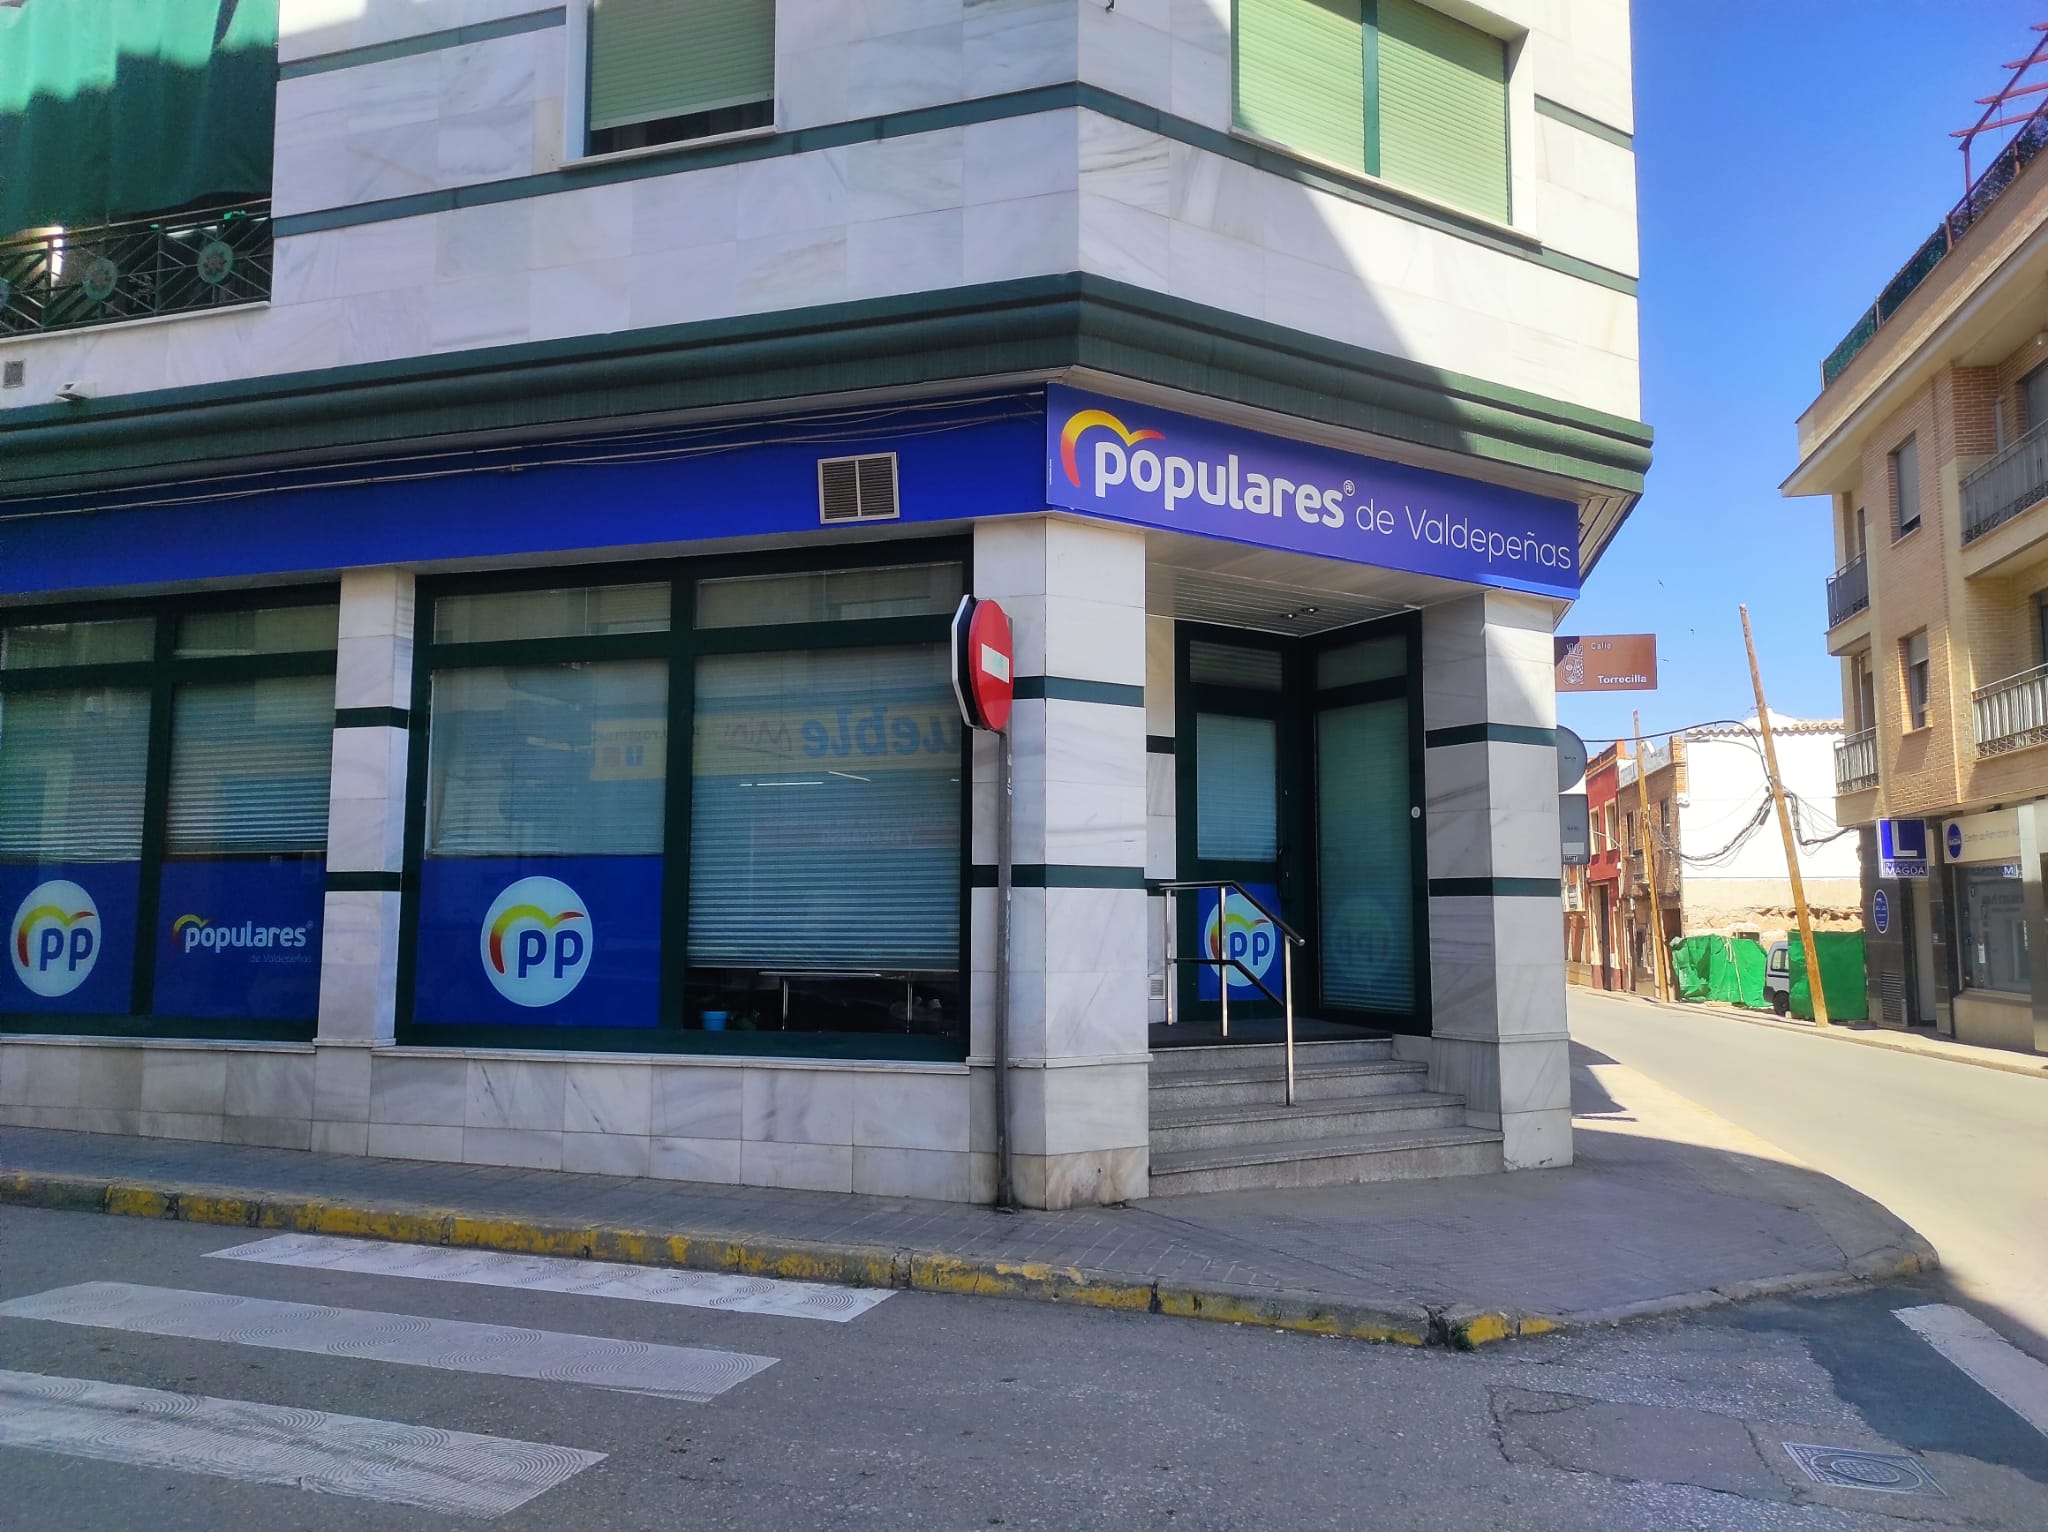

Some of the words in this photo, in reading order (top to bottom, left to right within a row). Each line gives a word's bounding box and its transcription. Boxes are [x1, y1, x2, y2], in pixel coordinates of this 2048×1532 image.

[1095, 440, 1344, 529] populares
[1355, 497, 1394, 536] de
[1405, 504, 1572, 571] Valdepeñas
[1590, 641, 1612, 650] Calle
[1597, 674, 1648, 684] Torrecilla
[1891, 820, 1918, 857] L
[1885, 866, 1925, 875] MAGDA
[185, 920, 306, 953] populares
